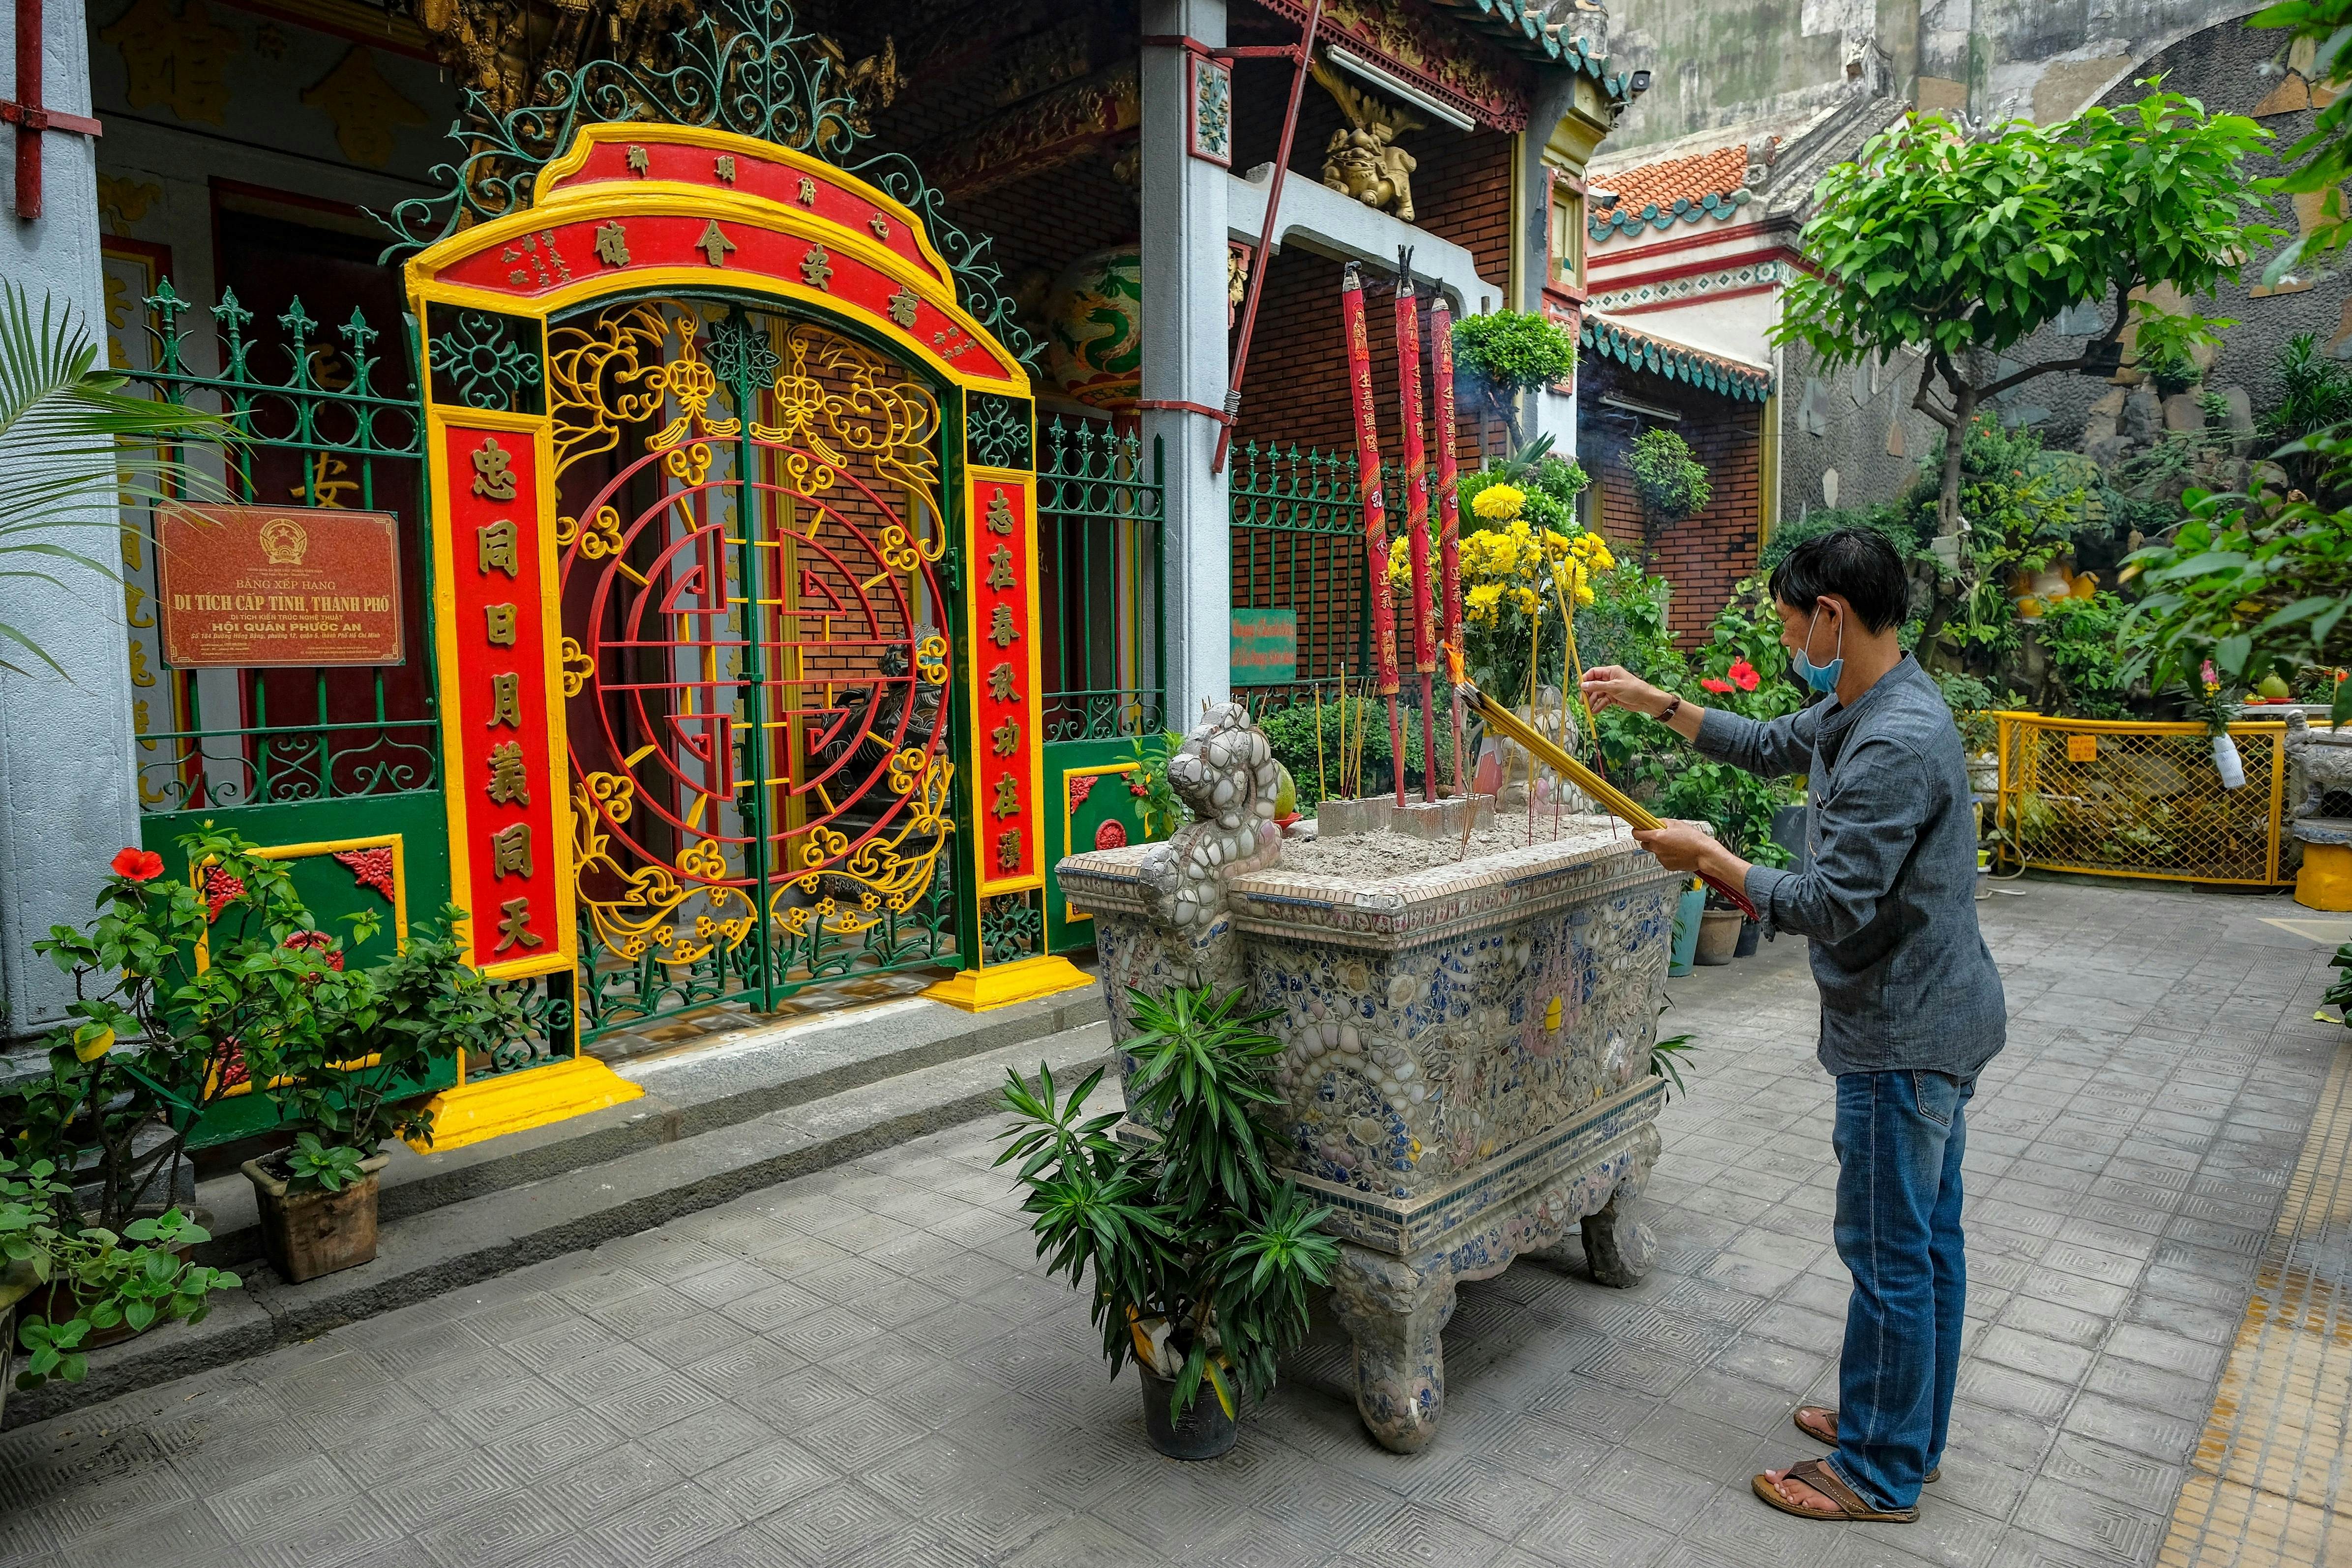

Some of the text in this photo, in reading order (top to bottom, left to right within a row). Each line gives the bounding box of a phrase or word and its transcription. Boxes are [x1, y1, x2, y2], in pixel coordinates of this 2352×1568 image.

[1358, 369, 1378, 452] 生意興隆
[174, 594, 192, 610] DI
[195, 592, 232, 611] TÍCH
[236, 592, 265, 611] CẤP
[311, 594, 360, 612] THÀNH
[363, 594, 389, 612] PHỐ
[274, 577, 298, 589] XẾP
[302, 581, 335, 591] HẠNG
[1377, 569, 1393, 609] 正氣
[212, 621, 361, 633] HỘI QUÁN PHƯỚC AN
[473, 438, 543, 951] 忠同日月義同天
[985, 487, 1023, 869] 志在春秋功在漢
